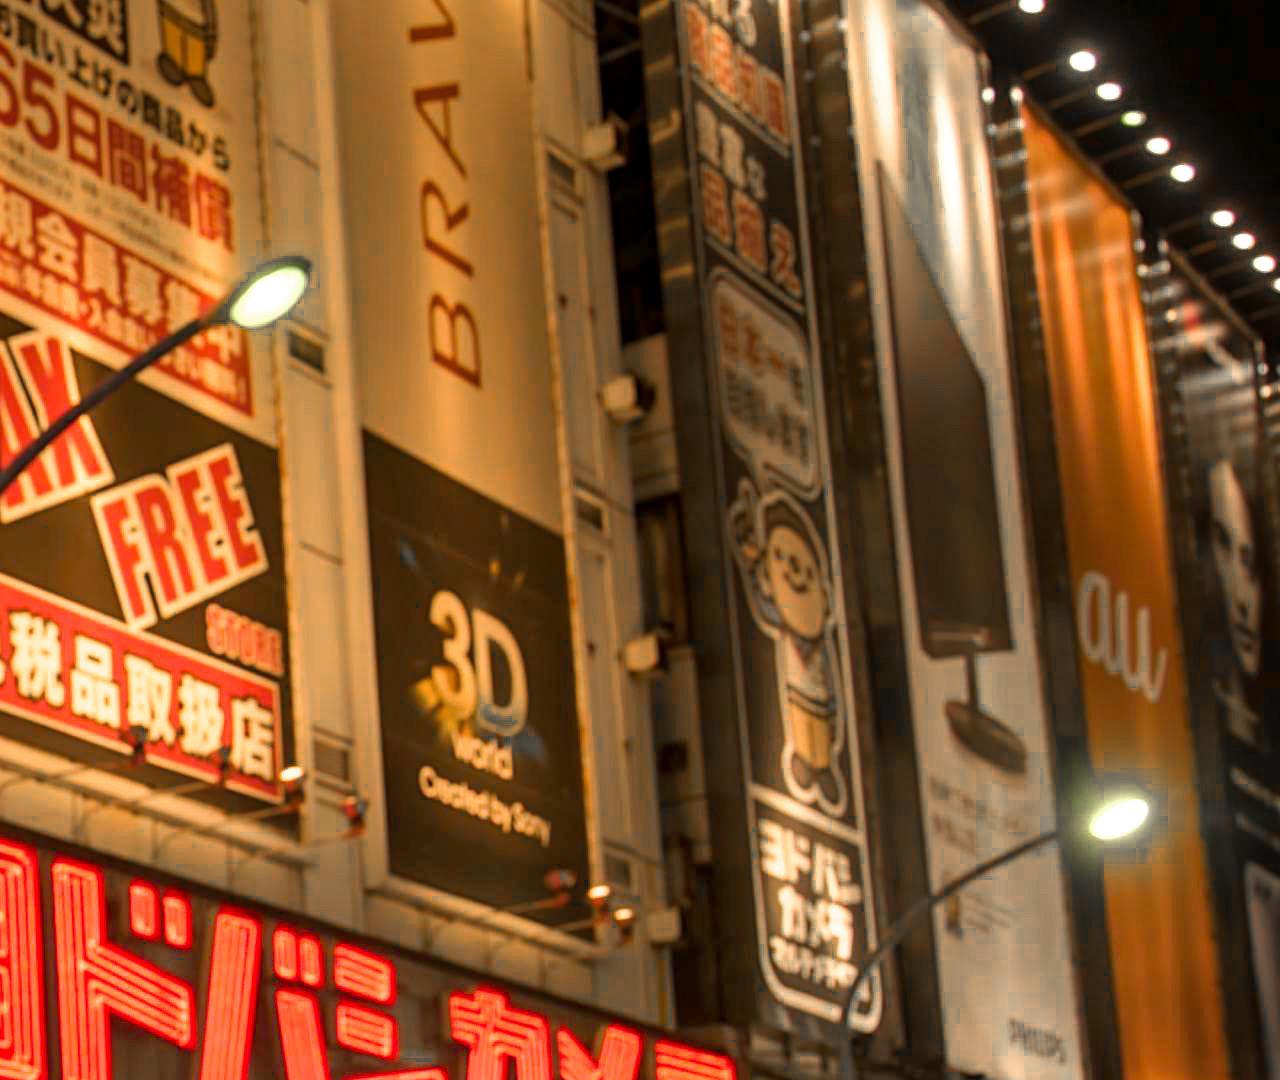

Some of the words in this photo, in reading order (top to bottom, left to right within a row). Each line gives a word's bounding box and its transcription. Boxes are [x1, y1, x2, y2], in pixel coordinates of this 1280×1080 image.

[93, 444, 269, 630] FREE
[430, 587, 529, 738] 3D
[1076, 568, 1170, 706] au
[418, 765, 490, 820] Created
